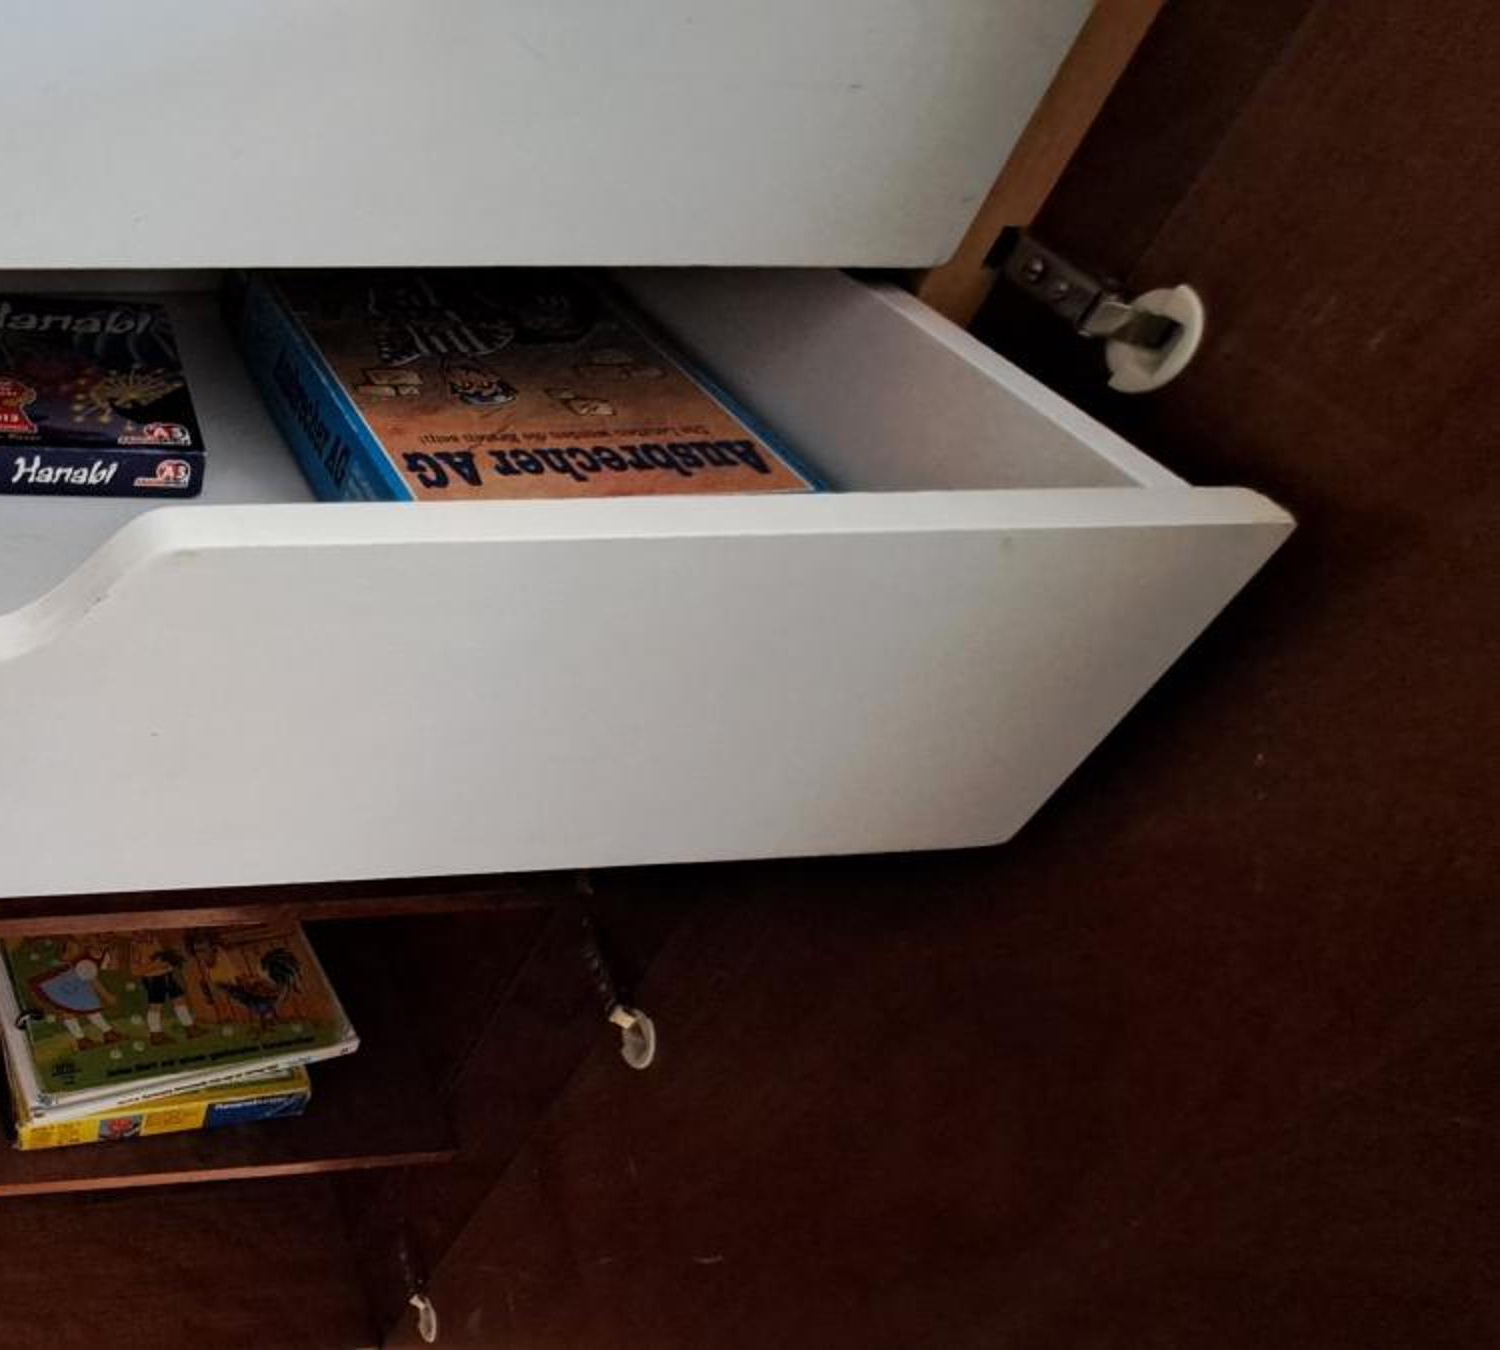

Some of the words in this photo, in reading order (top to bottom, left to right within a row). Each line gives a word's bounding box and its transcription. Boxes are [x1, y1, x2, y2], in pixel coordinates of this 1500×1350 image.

[11, 456, 120, 484] Hanabi
[402, 451, 484, 489] AG
[493, 439, 772, 481] Ausbrecher
